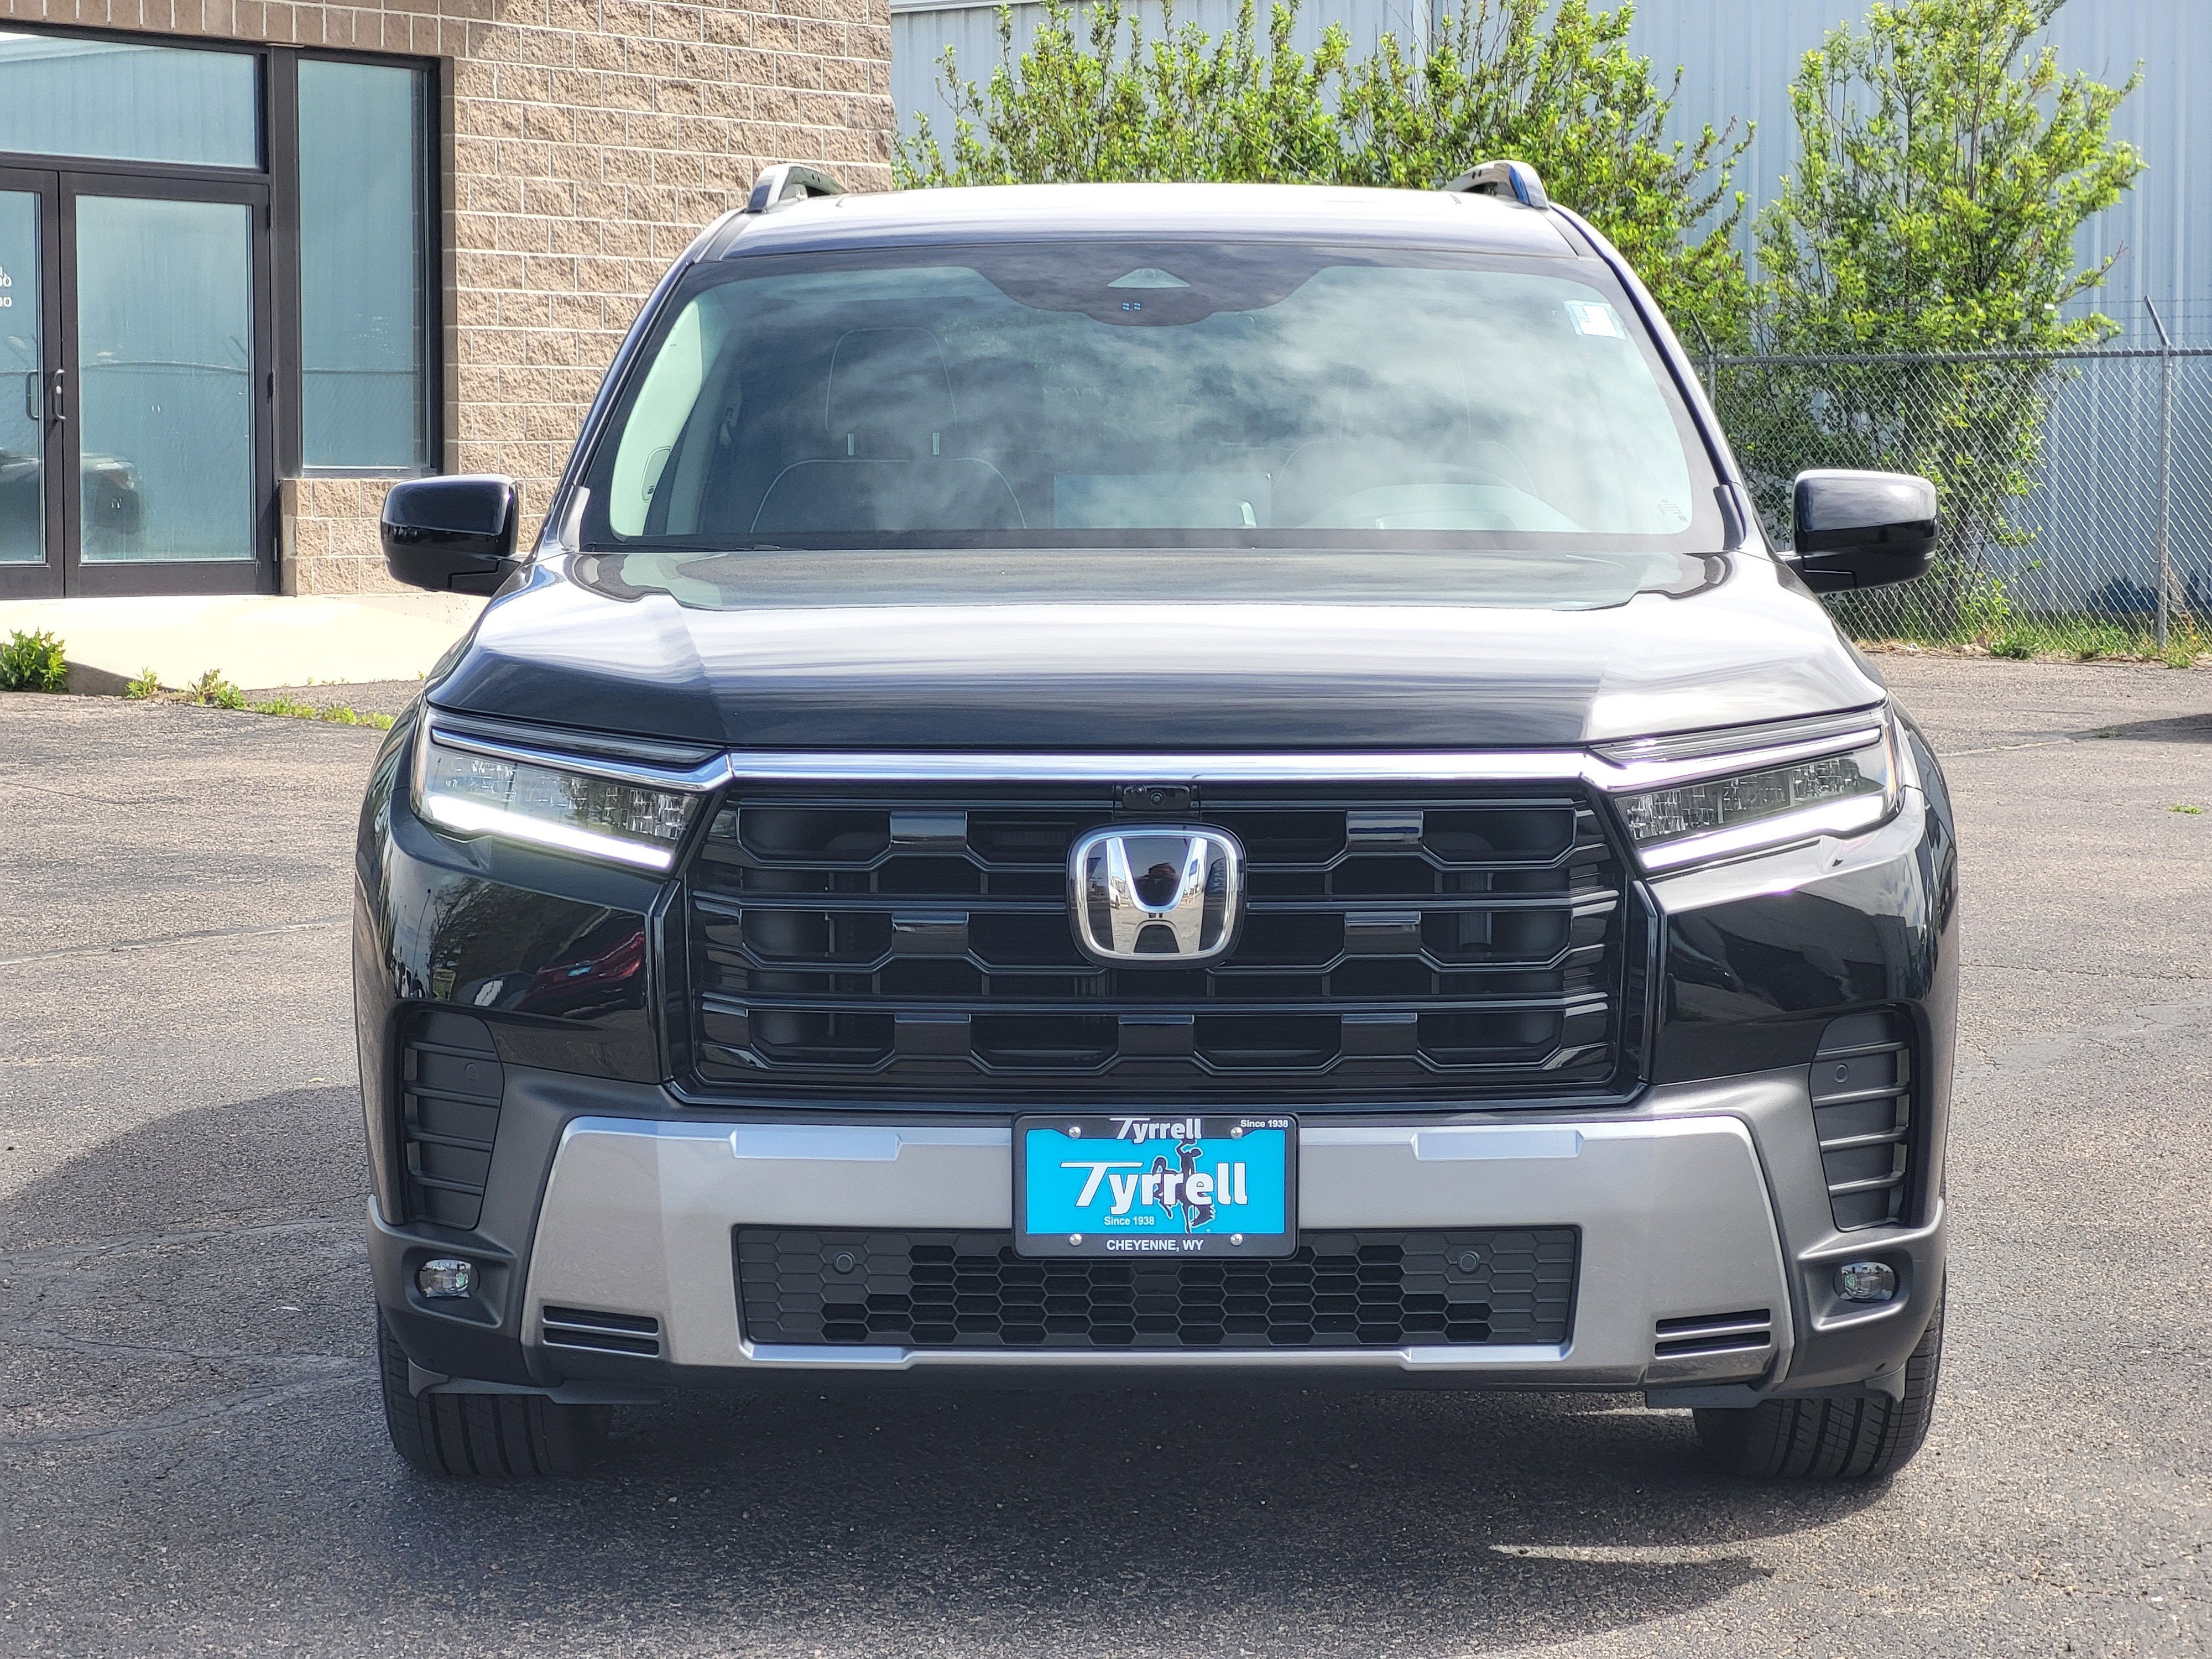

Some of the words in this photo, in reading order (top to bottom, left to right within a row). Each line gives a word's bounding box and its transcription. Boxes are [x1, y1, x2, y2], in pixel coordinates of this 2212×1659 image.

[1240, 1119, 1265, 1128] Since
[1267, 1119, 1288, 1128] 1938
[1109, 1118, 1202, 1144] Tyrrell
[1060, 1162, 1248, 1215] Tyrrell
[1104, 1216, 1130, 1225] Since
[1133, 1216, 1155, 1225] 1938
[1106, 1239, 1180, 1252] CHEYENNE,
[1182, 1239, 1204, 1251] WY
